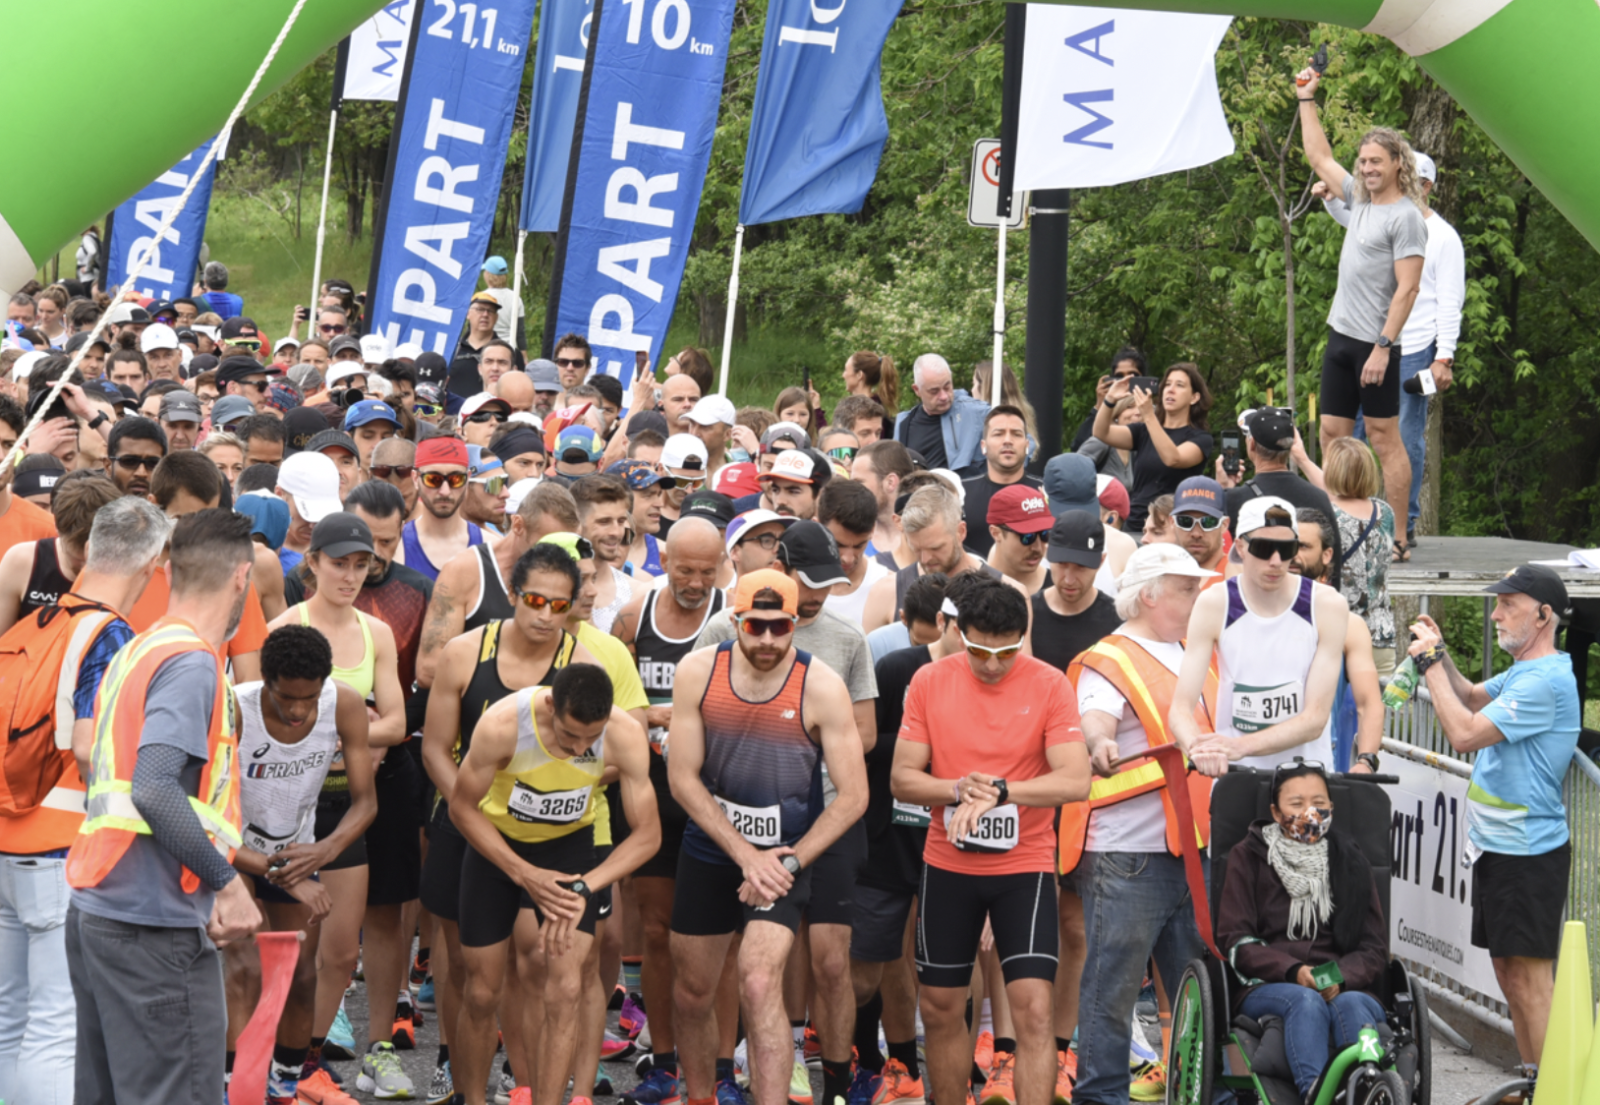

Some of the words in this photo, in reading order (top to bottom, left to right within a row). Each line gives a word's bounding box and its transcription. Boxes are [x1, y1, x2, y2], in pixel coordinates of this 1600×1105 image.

[622, 0, 692, 51] 10
[689, 37, 714, 56] km
[497, 37, 520, 56] km
[1262, 693, 1298, 720] 3741
[539, 793, 586, 816] 3265
[733, 810, 777, 837] 2260
